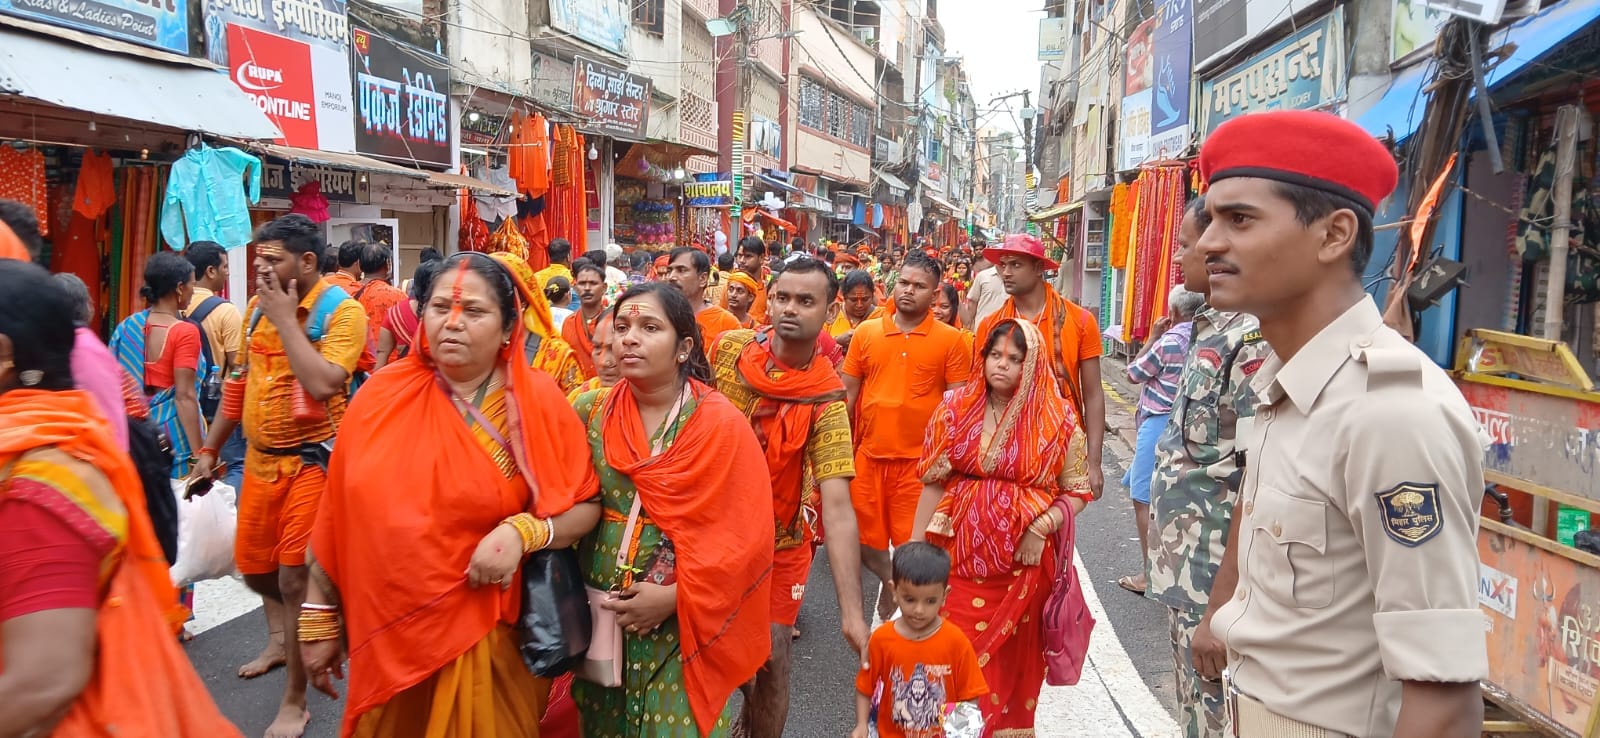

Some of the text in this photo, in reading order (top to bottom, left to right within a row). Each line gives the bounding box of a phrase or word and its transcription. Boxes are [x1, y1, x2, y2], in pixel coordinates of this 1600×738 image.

[57, 0, 70, 13] &
[72, 3, 117, 26] Ladies
[120, 13, 154, 36] Point
[247, 64, 283, 83] RUPA
[321, 101, 347, 112] EMPORIUM
[1479, 577, 1514, 608] NXT
